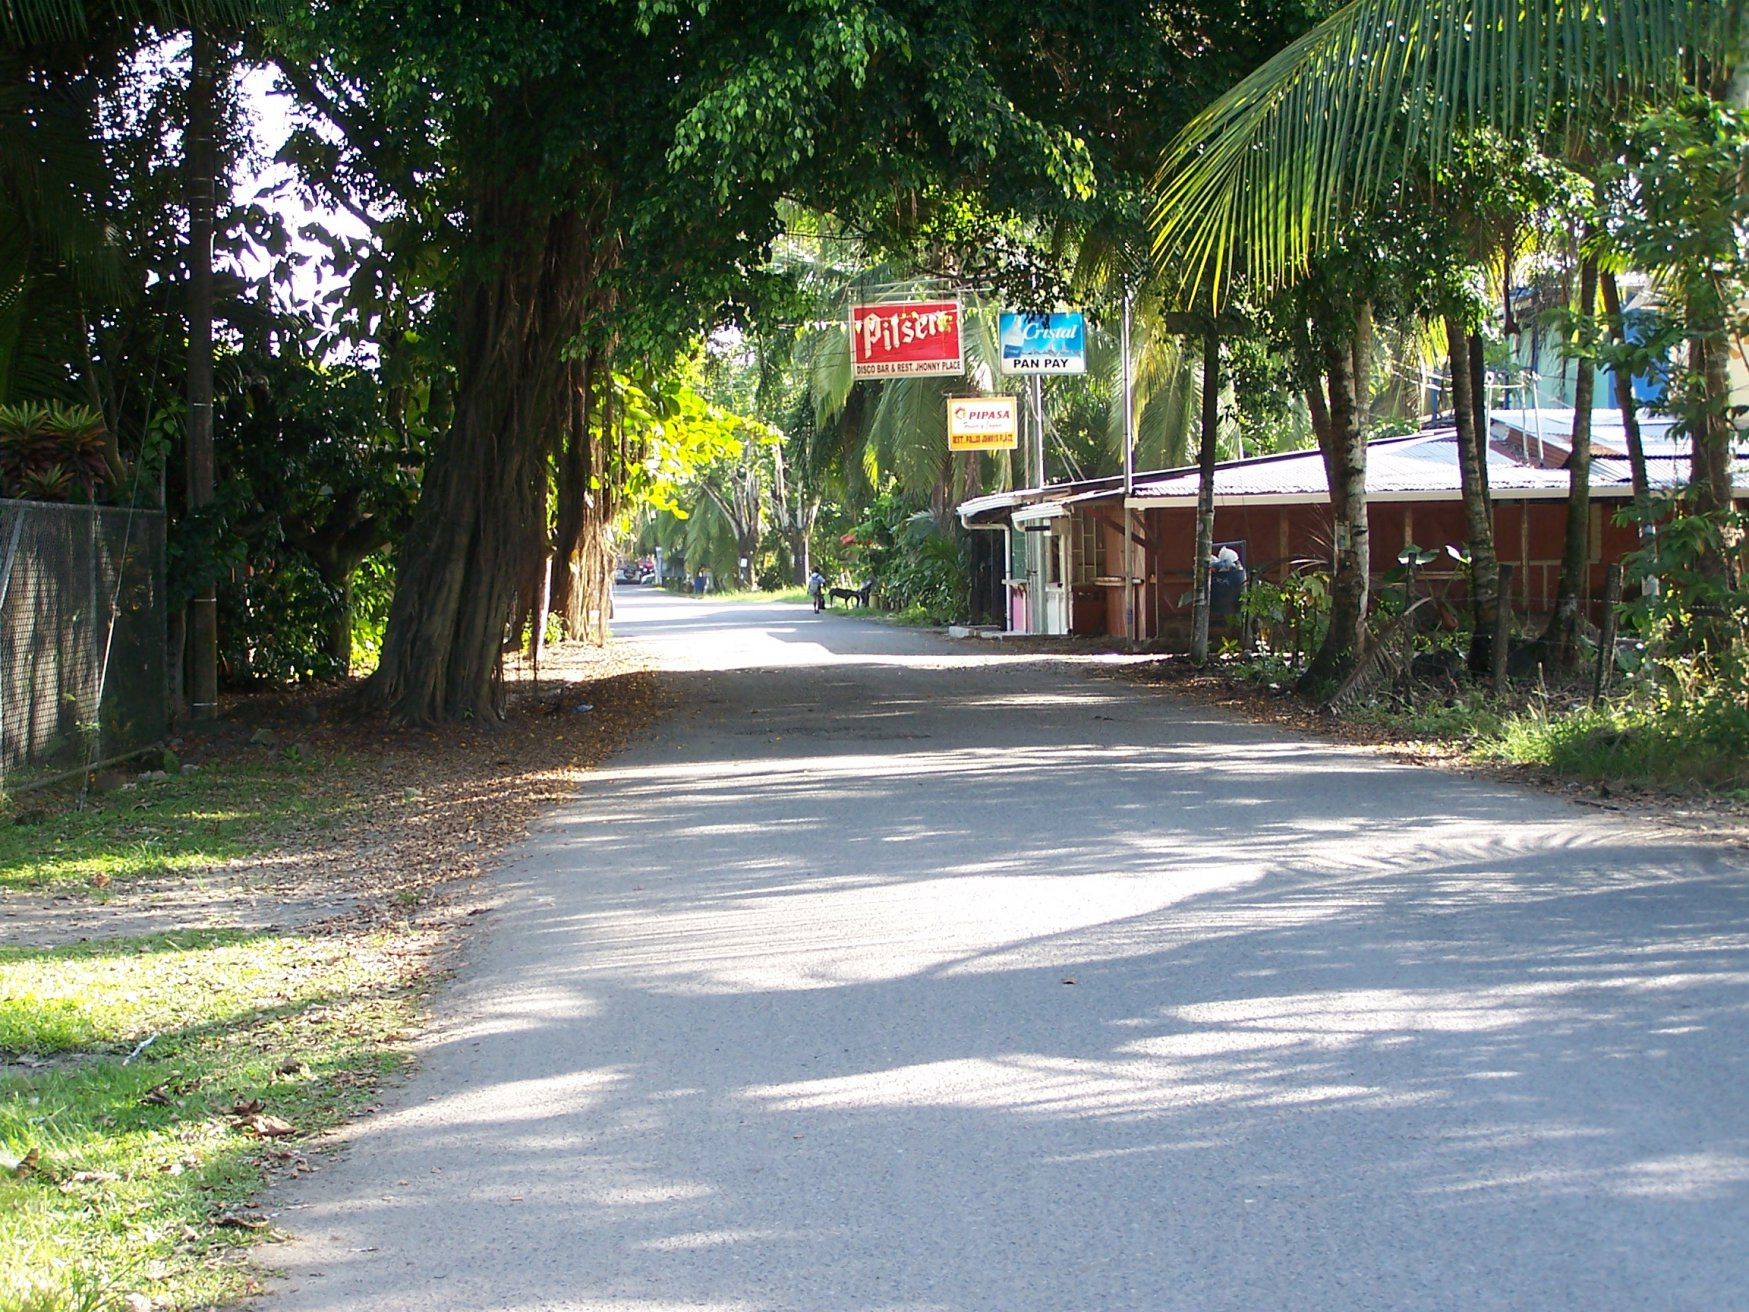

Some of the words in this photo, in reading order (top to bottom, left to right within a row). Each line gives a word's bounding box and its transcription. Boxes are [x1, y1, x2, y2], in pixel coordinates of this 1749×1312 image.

[1023, 322, 1078, 340] Cristal
[857, 365, 876, 375] DISCO
[877, 364, 889, 374] BAR
[891, 363, 896, 373] &
[897, 362, 913, 373] REST.
[915, 361, 940, 372] JHONNY
[942, 360, 961, 371] PLACE
[1013, 359, 1040, 369] PAN
[1044, 359, 1069, 368] PAY
[969, 410, 1010, 420] PIPASA
